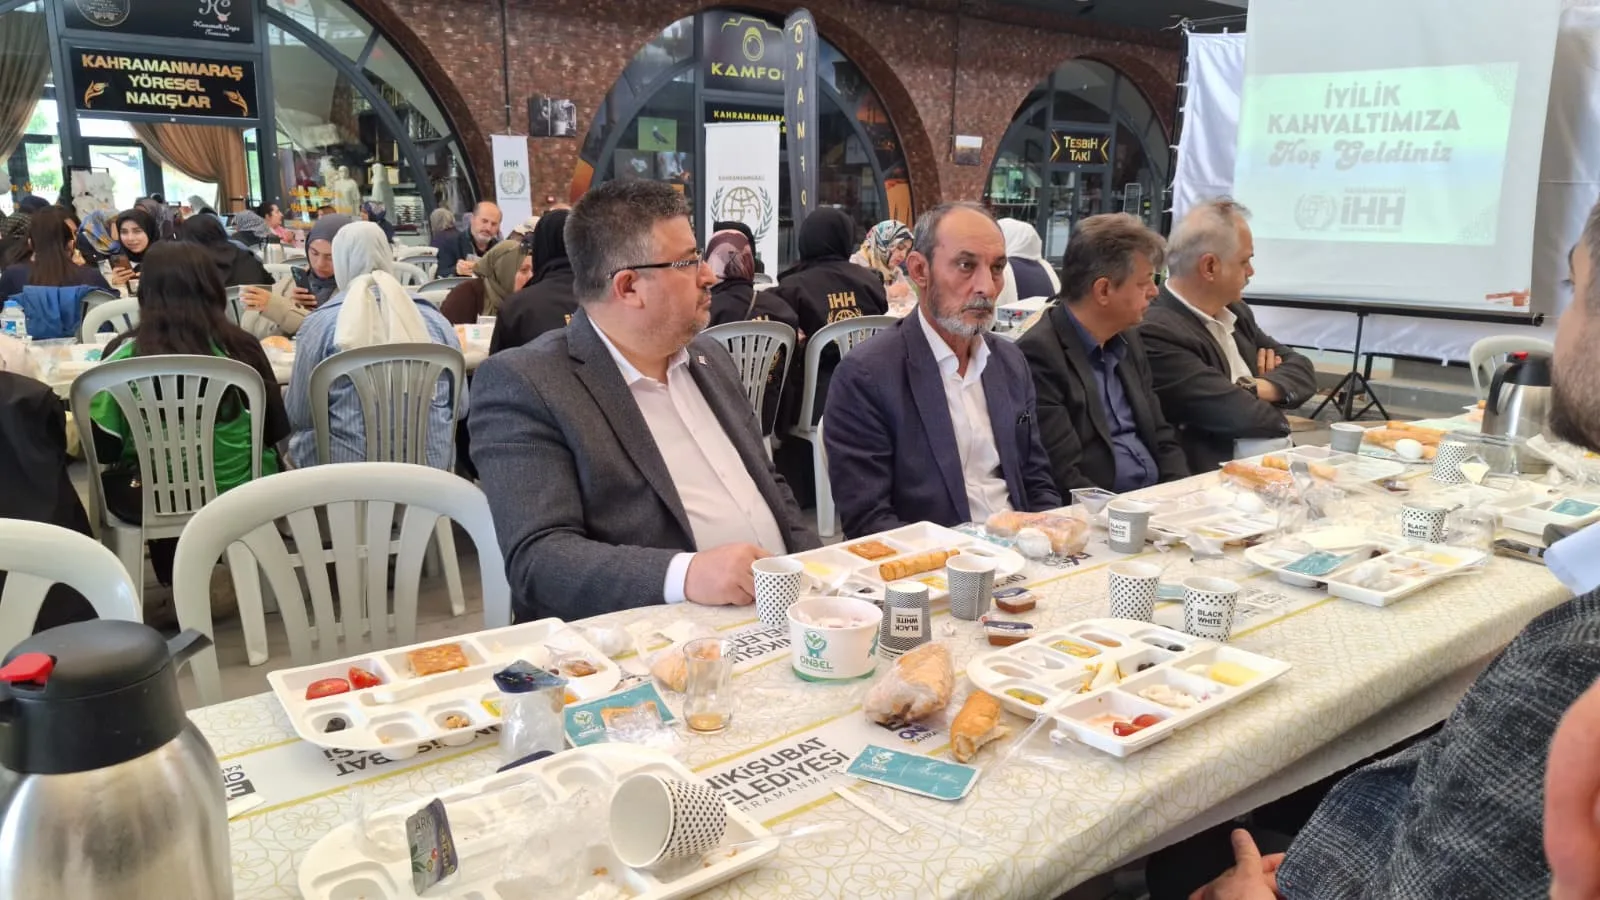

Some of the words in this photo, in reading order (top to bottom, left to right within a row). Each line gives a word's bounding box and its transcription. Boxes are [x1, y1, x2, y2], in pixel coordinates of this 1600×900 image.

[82, 54, 243, 81] KAHRAMANMARAŞ
[711, 62, 785, 81] KAMFO
[129, 74, 206, 93] YÖRESEL
[126, 93, 211, 110] NAKIŞLAR
[1324, 80, 1401, 109] İYİLİK
[713, 110, 786, 122] KAHRAMANMARA
[1267, 109, 1462, 135] KAHVALTIMIZA
[1069, 149, 1091, 161] TAKI
[1268, 138, 1321, 170] Hoş
[1333, 138, 1453, 171] Geldiniz
[1407, 523, 1428, 531] BLACK
[1407, 529, 1427, 537] WHITE
[1197, 609, 1223, 618] BLACK
[1197, 616, 1222, 625] WHITE
[895, 624, 919, 632] BLACK
